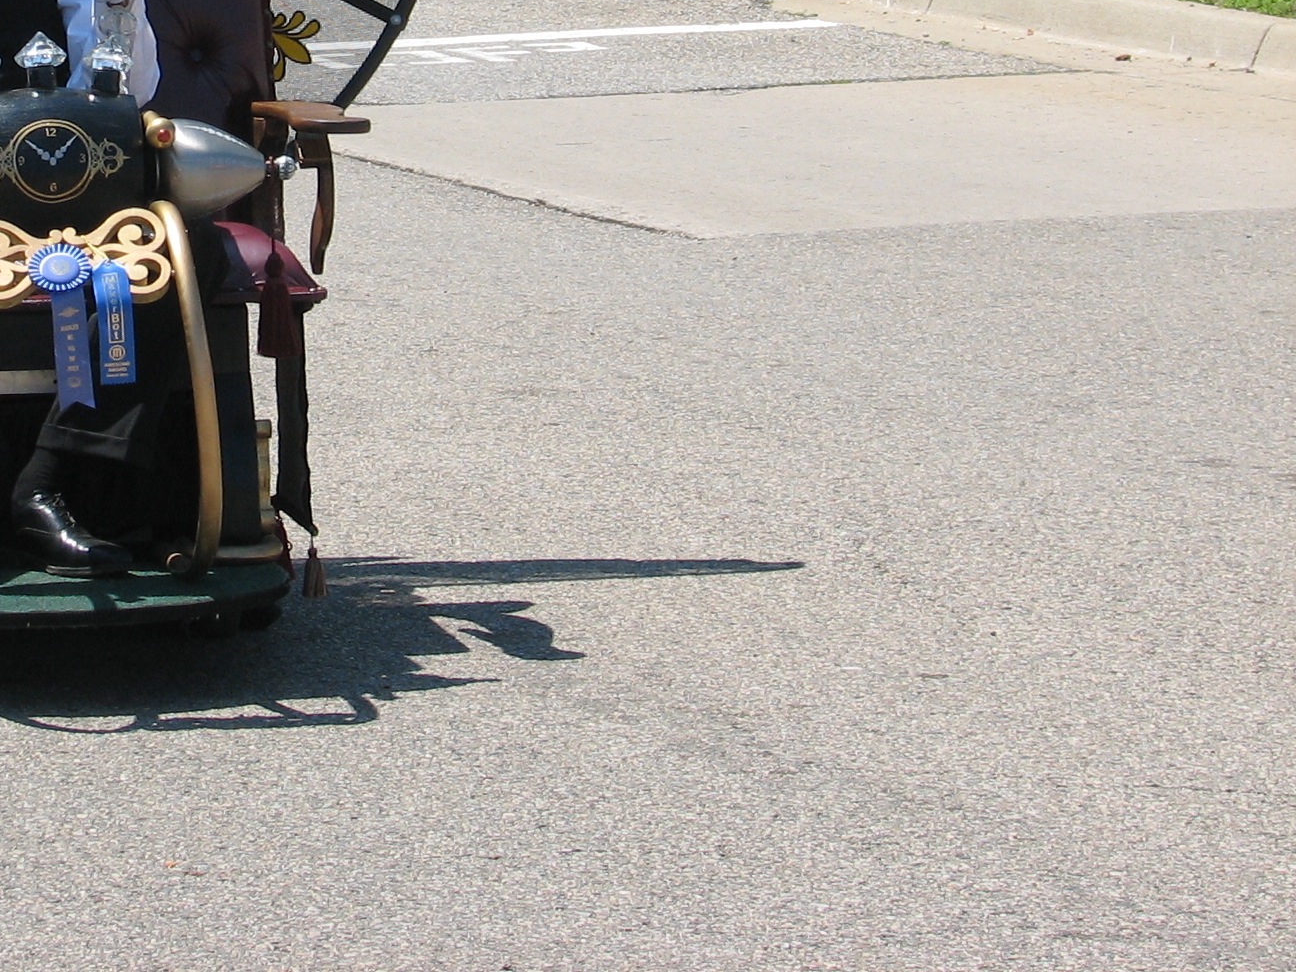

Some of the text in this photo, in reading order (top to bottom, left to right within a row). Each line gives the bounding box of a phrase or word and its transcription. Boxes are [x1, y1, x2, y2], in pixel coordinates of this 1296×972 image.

[45, 127, 57, 137] 12
[18, 155, 25, 166] 9
[79, 153, 86, 163] 3
[50, 182, 57, 192] 6
